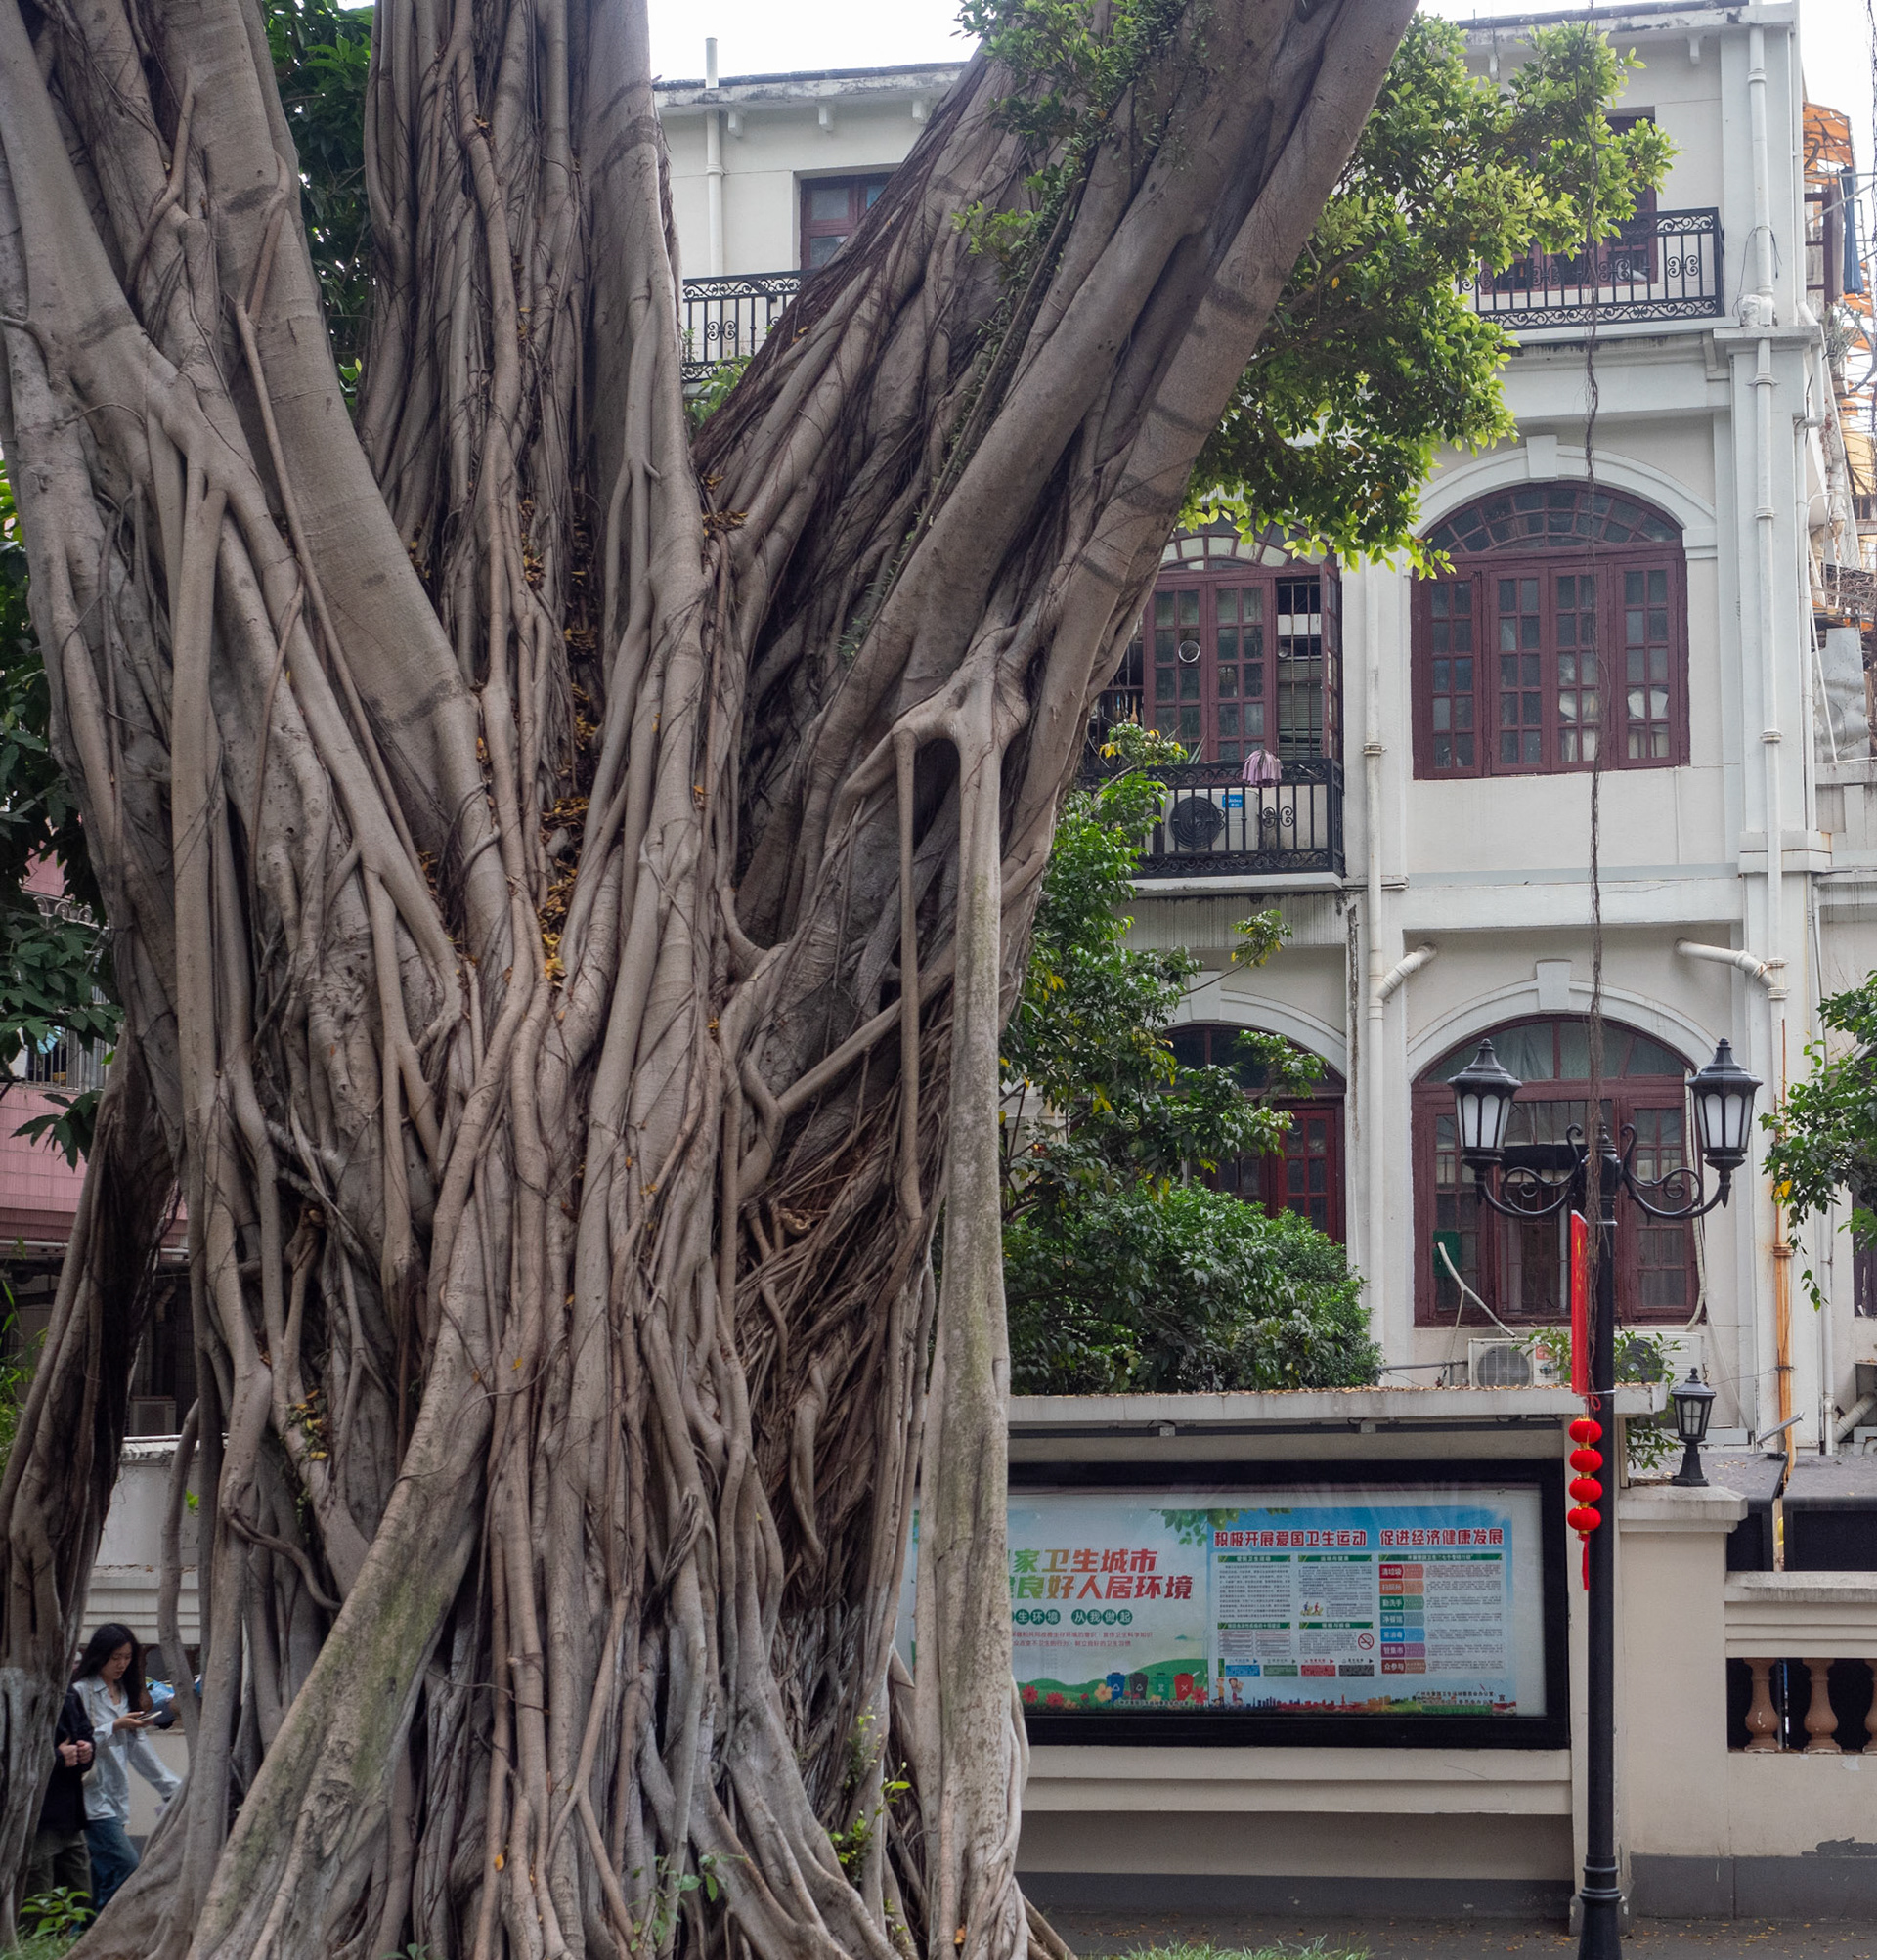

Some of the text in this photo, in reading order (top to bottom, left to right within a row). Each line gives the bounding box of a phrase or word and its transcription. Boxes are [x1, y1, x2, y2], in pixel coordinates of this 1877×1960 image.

[1215, 1529, 1504, 1547] 积极开展爱国卫生运动 促进经济健康发展
[1008, 1548, 1157, 1574] 家卫生城市
[1010, 1575, 1192, 1600] 良好人居环境
[1073, 1610, 1131, 1623] 从我做起
